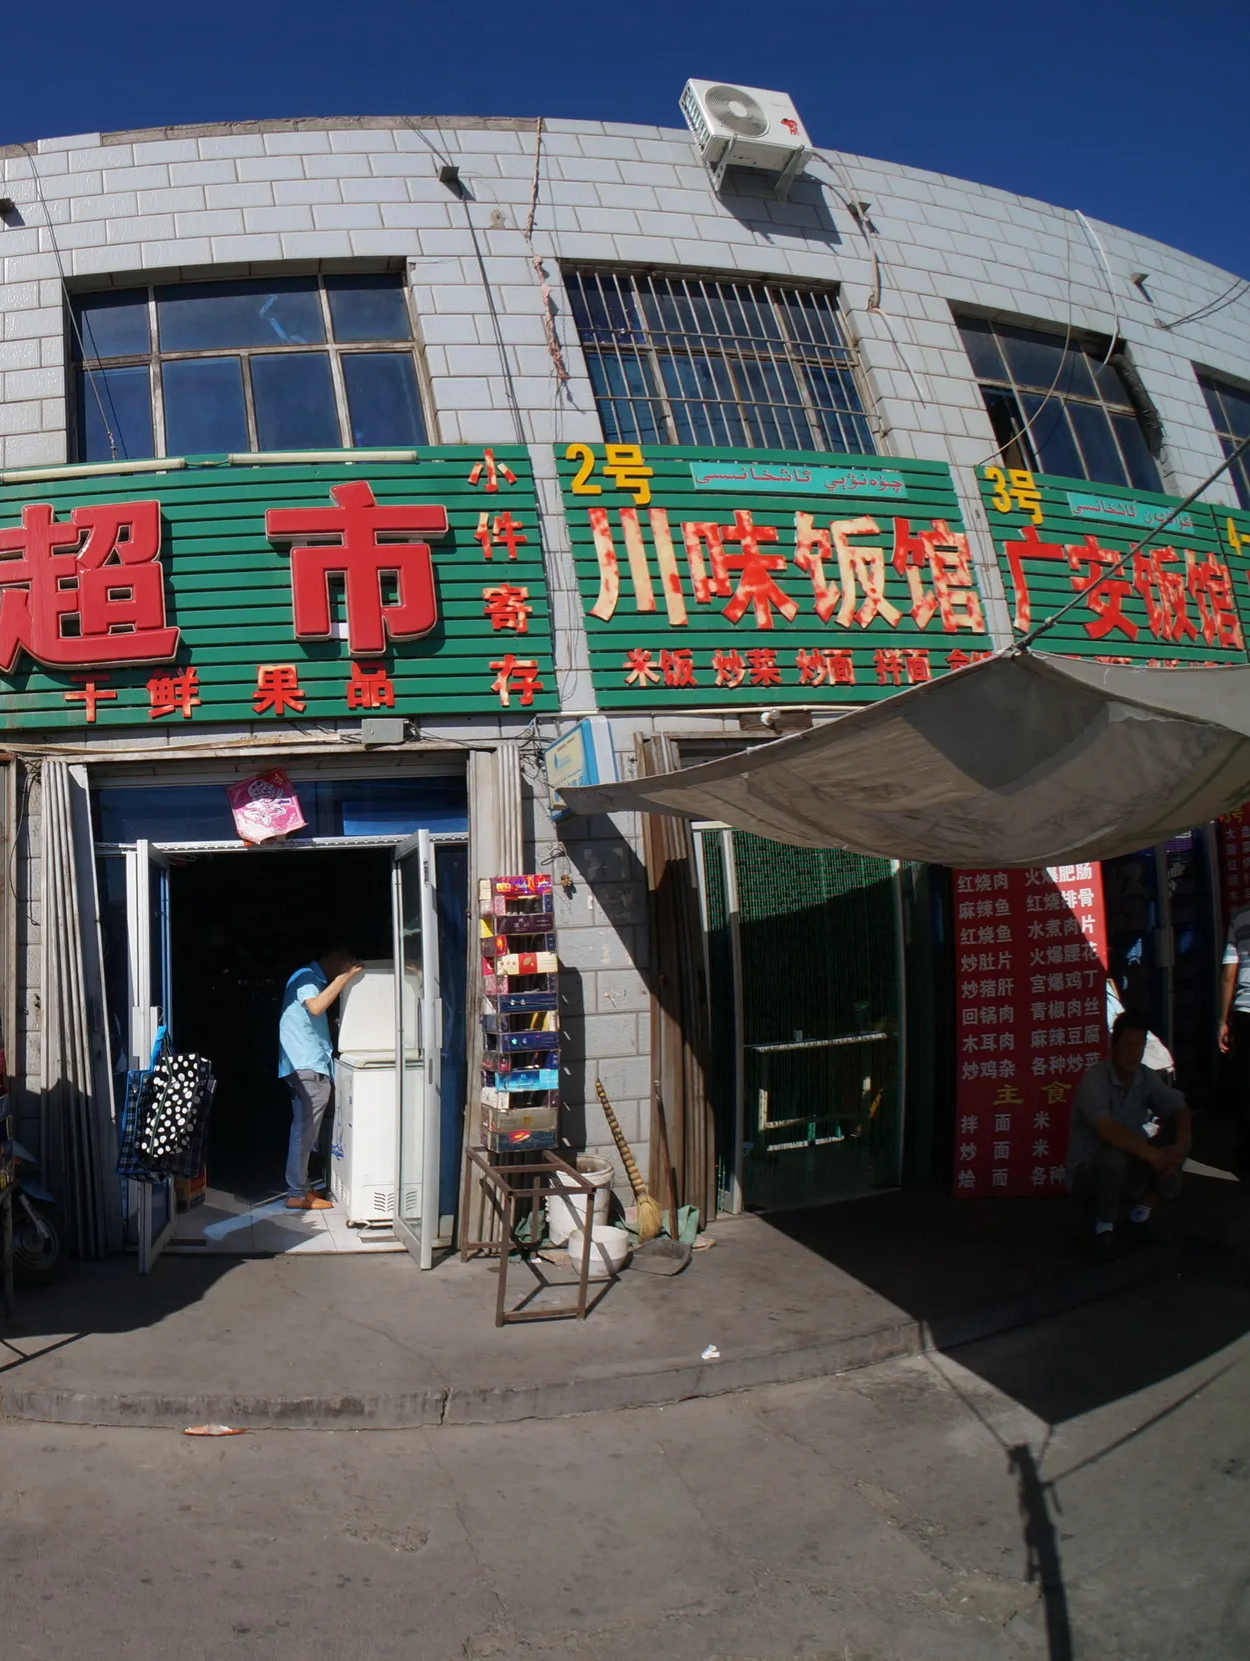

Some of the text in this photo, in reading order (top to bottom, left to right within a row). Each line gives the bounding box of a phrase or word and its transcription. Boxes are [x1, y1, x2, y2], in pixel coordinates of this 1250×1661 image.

[565, 443, 653, 505] 2号
[984, 466, 1044, 525] 3号
[1227, 517, 1250, 555] 4
[467, 448, 544, 707] 小件寄存
[589, 507, 988, 633] 川味饭馆
[1004, 525, 1244, 650] 广安饭馆
[623, 647, 697, 687] 米饭
[711, 648, 781, 687] 炒菜
[796, 648, 854, 685] 炒面
[873, 649, 932, 686] 拌面
[64, 662, 395, 723] 干鲜果品
[958, 862, 1093, 893] 红烧肉 火爆肥肠
[958, 888, 1095, 920] 麻辣鱼 红烧排骨
[960, 914, 1096, 945] 红烧鱼 水煮肉片
[960, 941, 1098, 973] 炒肚片 火爆腰花
[961, 977, 1014, 999] 炒猪肝
[962, 998, 1100, 1026] 回锅肉 青椒肉丝
[962, 1024, 1101, 1053] 木耳肉 麻辣豆腐
[962, 1051, 1101, 1080] 炒鸡杂 各种炒菜
[992, 1080, 1072, 1106] 主食
